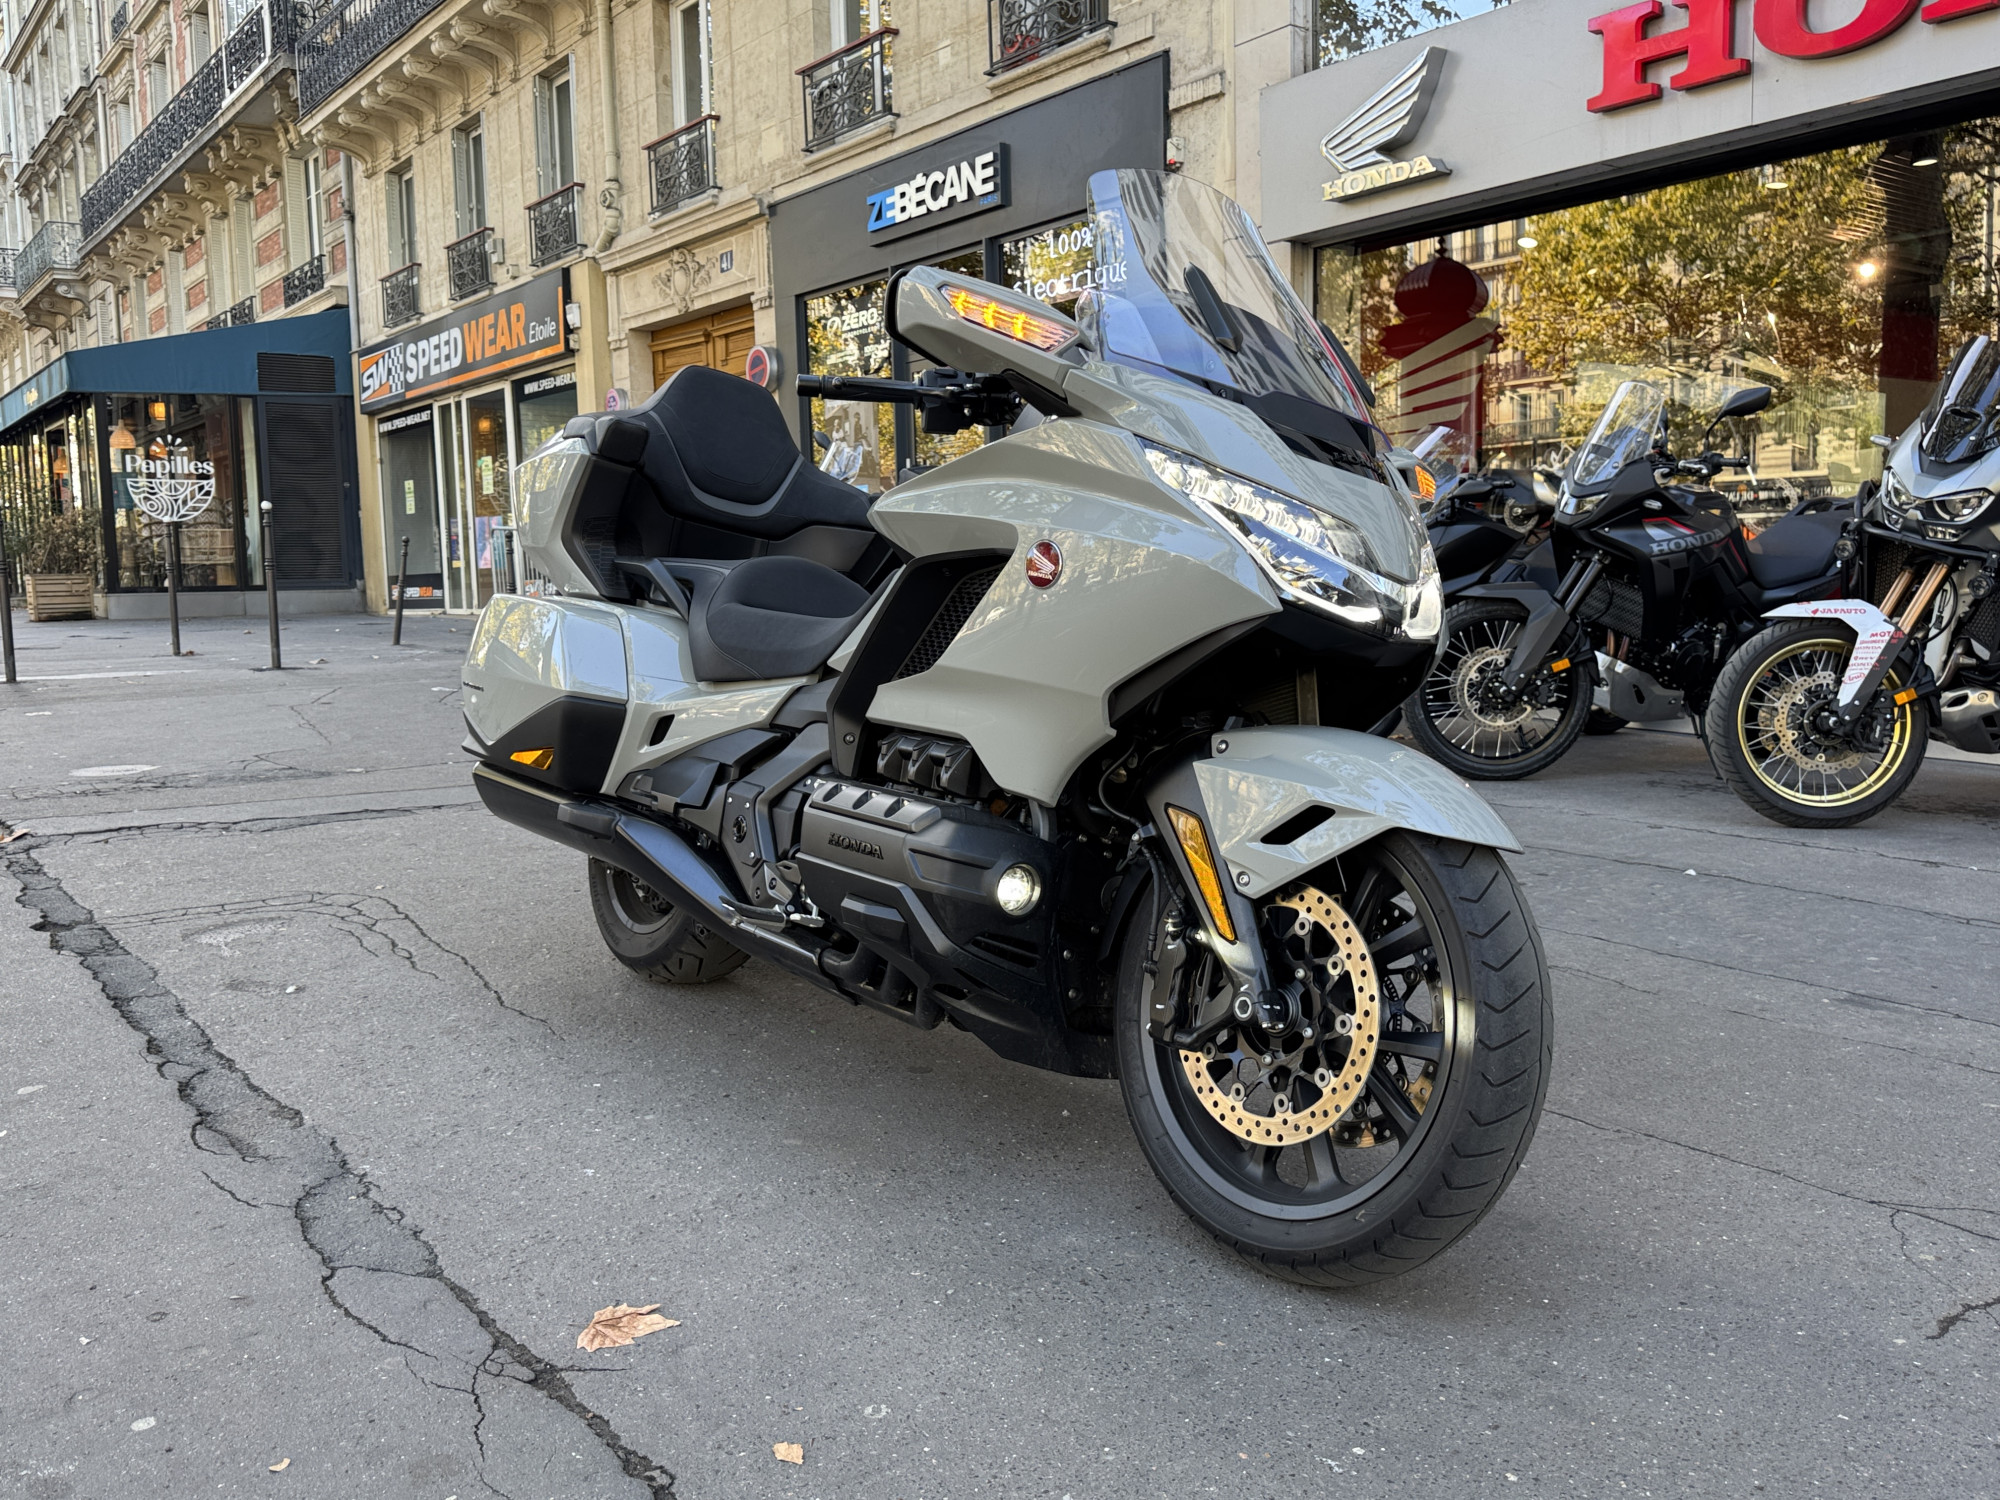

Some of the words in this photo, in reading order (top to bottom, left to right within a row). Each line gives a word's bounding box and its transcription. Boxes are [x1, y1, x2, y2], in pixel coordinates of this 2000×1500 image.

[1587, 0, 2000, 113] HO
[1322, 155, 1437, 201] HONDA
[721, 251, 731, 270] 41
[529, 317, 556, 344] Etoile
[841, 308, 878, 331] ZERO
[361, 351, 390, 399] SW
[379, 410, 431, 433] WWW.SPEED-WEAR.NET
[125, 454, 215, 478] Papilles
[1649, 528, 1726, 556] HONDA
[1870, 630, 1904, 639] MOTUL
[827, 832, 884, 860] HONDA
